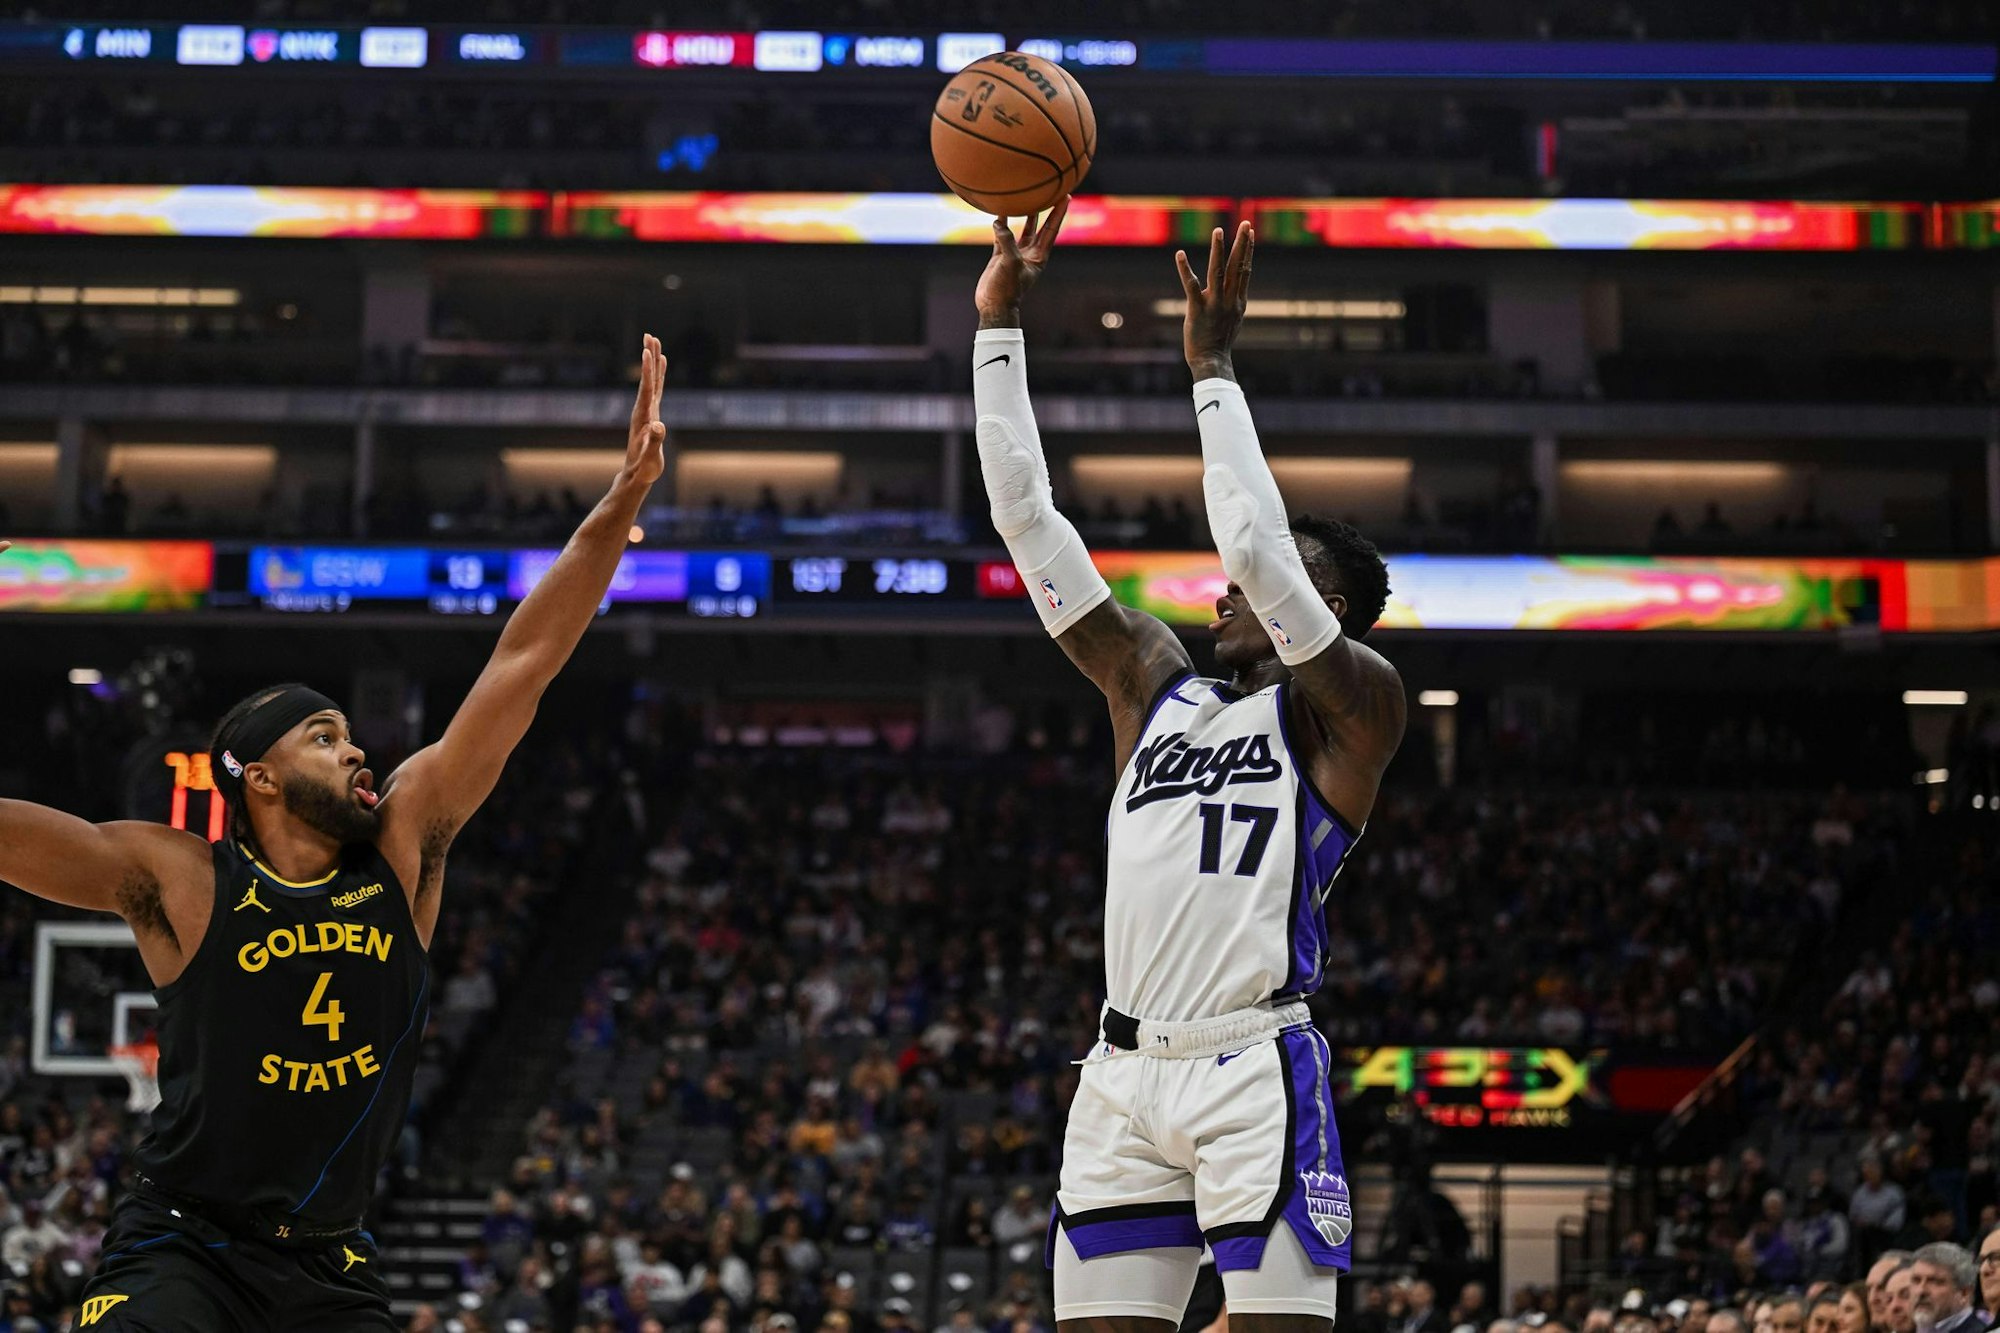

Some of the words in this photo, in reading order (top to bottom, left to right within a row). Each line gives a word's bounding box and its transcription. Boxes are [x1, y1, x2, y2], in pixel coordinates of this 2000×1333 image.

[460, 33, 525, 60] FINAL
[673, 35, 735, 65] HOU
[790, 557, 847, 593] 1ST
[1126, 732, 1282, 814] Kings
[1199, 803, 1279, 877] 17
[331, 882, 384, 908] Rakuten
[238, 922, 394, 973] GOLDEN
[302, 972, 345, 1042] 4
[258, 1044, 381, 1093] STATE
[1309, 1200, 1351, 1219] KINGS
